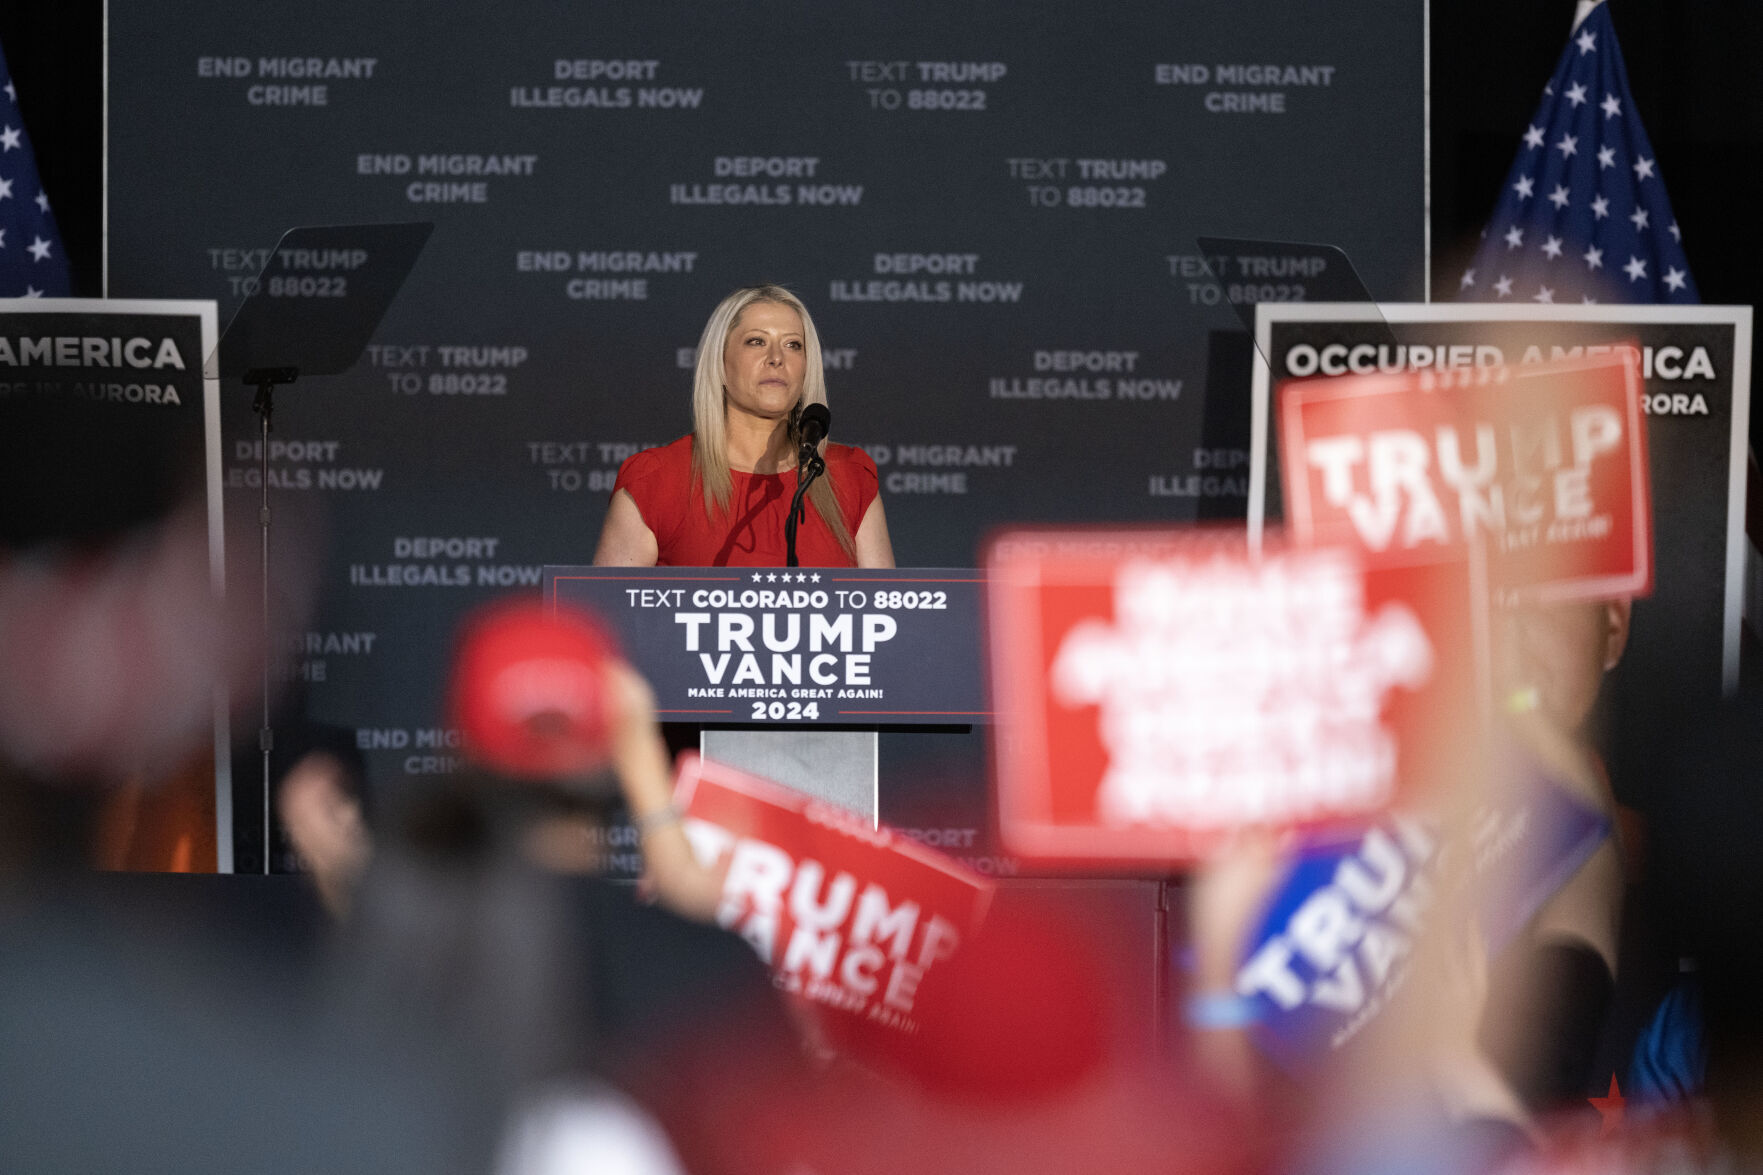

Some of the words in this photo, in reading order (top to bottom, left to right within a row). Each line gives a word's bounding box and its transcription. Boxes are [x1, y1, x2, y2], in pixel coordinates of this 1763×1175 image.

[198, 57, 252, 78] END
[259, 57, 377, 79] MIGRANT
[555, 60, 659, 80] DEPORT
[847, 61, 909, 82] TEXT
[917, 62, 1007, 82] TRUMP
[1155, 64, 1209, 84] END
[1216, 65, 1334, 85] MIGRANT
[248, 85, 327, 106] CRIME
[511, 87, 632, 108] ILLEGALS
[638, 88, 703, 108] NOW
[868, 88, 901, 110] TO
[908, 89, 986, 110] 88022
[1205, 92, 1285, 113] CRIME
[357, 154, 411, 175] END
[418, 155, 537, 175] MIGRANT
[715, 157, 819, 177] DEPORT
[1007, 158, 1068, 179] TEXT
[1077, 159, 1166, 180] TRUMP
[407, 182, 487, 203] CRIME
[671, 184, 791, 205] ILLEGALS
[798, 185, 863, 205] NOW
[1027, 186, 1061, 207] TO
[1067, 187, 1145, 208] 88022
[208, 249, 270, 270] TEXT
[279, 250, 367, 270] TRUMP
[517, 251, 571, 272] END
[578, 252, 697, 272] MIGRANT
[874, 253, 978, 274] DEPORT
[1167, 256, 1228, 277] TEXT
[1237, 257, 1326, 277] TRUMP
[228, 276, 262, 297] TO
[269, 277, 346, 297] 88022
[567, 279, 647, 300] CRIME
[830, 281, 951, 301] ILLEGALS
[958, 282, 1022, 302] NOW
[1187, 283, 1221, 304] TO
[1229, 284, 1306, 304] 88022
[0, 337, 186, 370] AMERICA
[369, 346, 430, 366] TEXT
[438, 347, 527, 367] TRUMP
[1034, 351, 1138, 371] DEPORT
[1286, 344, 1504, 377] OCCUPIED
[388, 373, 422, 395] TO
[429, 374, 507, 395] 88022
[990, 378, 1111, 399] ILLEGALS
[1117, 380, 1182, 400] NOW
[1640, 394, 1709, 414] RORA
[236, 441, 339, 461] DEPORT
[528, 442, 589, 463] TEXT
[897, 445, 1016, 465] MIGRANT
[1193, 447, 1249, 469] DEP
[222, 469, 311, 490] EGALS
[319, 470, 383, 490] NOW
[548, 470, 582, 491] TO
[887, 472, 966, 493] CRIME
[1148, 475, 1248, 497] ILLEGA
[395, 538, 498, 559] DEPORT
[351, 565, 471, 586] ILLEGALS
[478, 566, 542, 586] NOW
[626, 589, 686, 608] TEXT
[692, 590, 829, 608] COLORADO
[836, 591, 867, 609] TO
[873, 591, 947, 610] 88022
[305, 632, 376, 654] RANT
[675, 612, 898, 653] TRUMP
[699, 653, 871, 685] VANCE
[688, 688, 724, 698] MAKE
[728, 688, 787, 699] AMERICA
[791, 689, 833, 699] GREAT
[837, 689, 883, 699] AGAIN!
[751, 701, 820, 720] 2024
[356, 729, 409, 749] END
[908, 829, 976, 848] PORT
[716, 895, 925, 1014] ANCE
